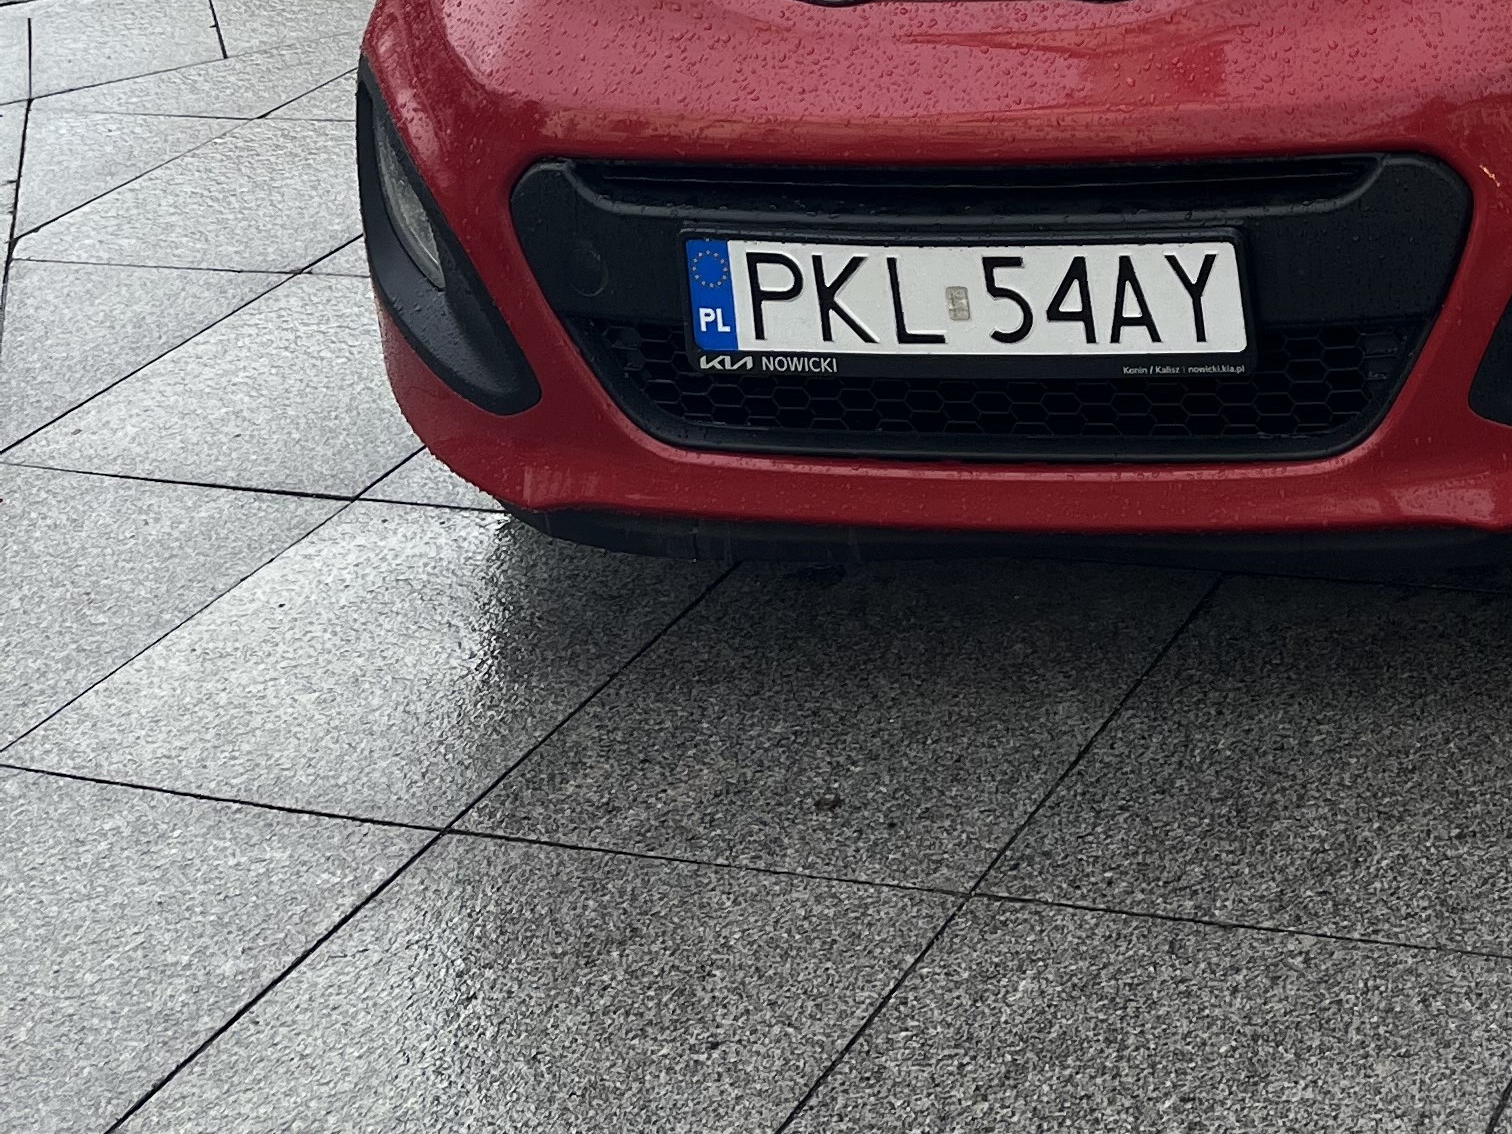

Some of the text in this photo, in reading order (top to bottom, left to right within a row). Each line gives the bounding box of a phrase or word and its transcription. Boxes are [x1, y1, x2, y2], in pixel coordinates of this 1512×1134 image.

[745, 251, 1218, 345] PKL 54AY
[699, 307, 731, 333] PL
[700, 355, 837, 373] KIA NOWICKI
[1155, 365, 1180, 374] Kalisz
